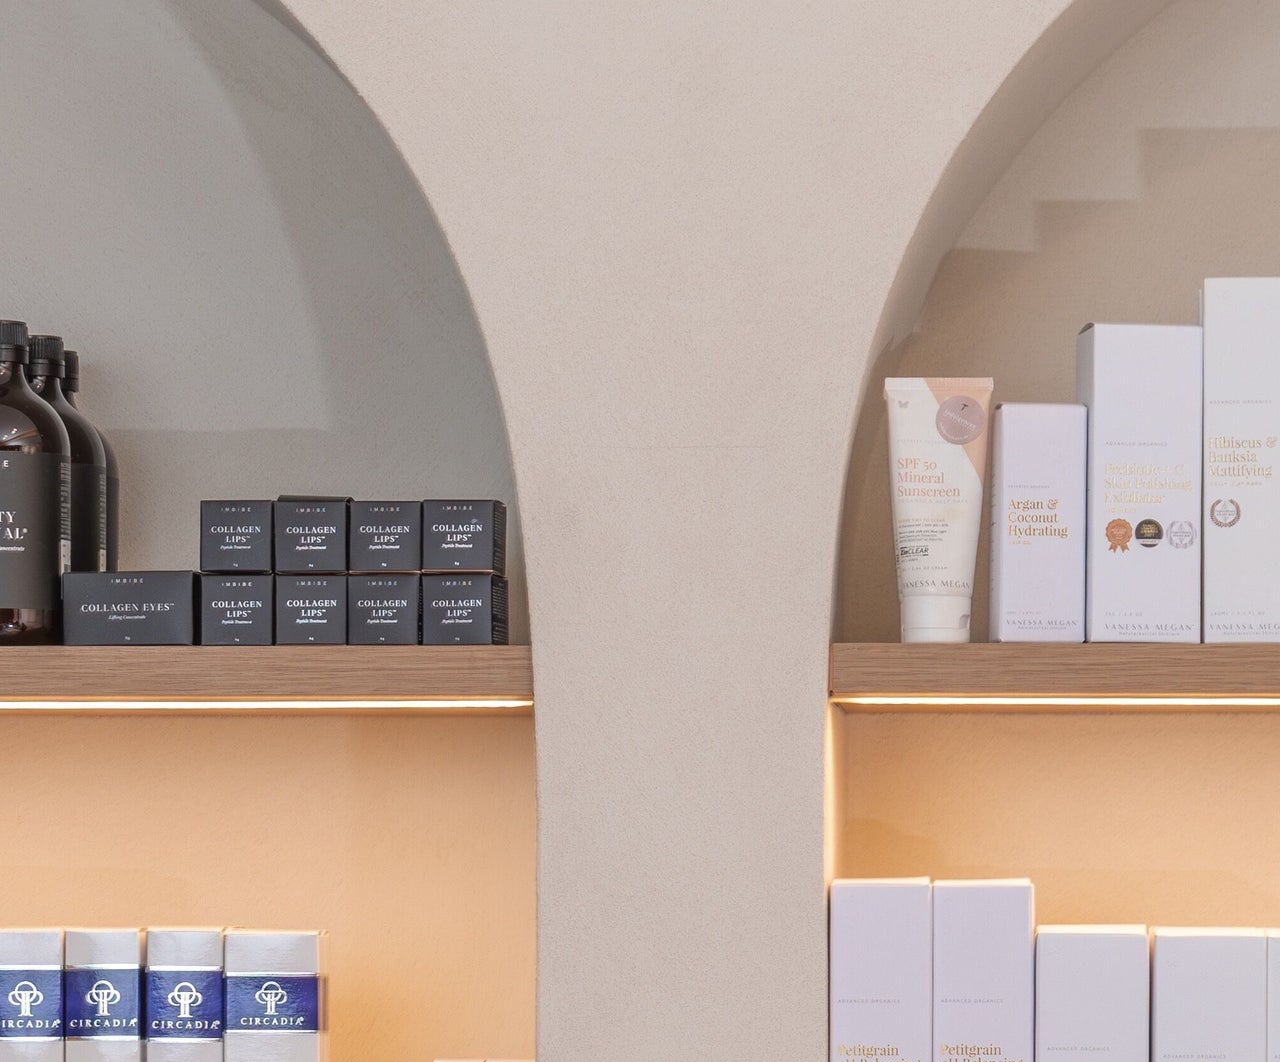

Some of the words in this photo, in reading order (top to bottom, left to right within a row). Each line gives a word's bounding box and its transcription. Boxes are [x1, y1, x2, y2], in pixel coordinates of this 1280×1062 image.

[1209, 436, 1262, 449] Hibiscus
[1266, 436, 1278, 449] &
[1209, 451, 1258, 463] Banksia
[897, 458, 921, 470] SPF
[922, 460, 938, 471] 50
[1209, 465, 1273, 478] Mattifying
[897, 472, 945, 484] Mineral
[896, 486, 961, 497] Sunscreen
[1008, 499, 1044, 511] Argan
[1047, 498, 1058, 510] &
[1008, 512, 1059, 524] Coconut
[210, 525, 262, 534] COLLAGEN
[359, 525, 410, 534] COLLAGEN
[1008, 525, 1068, 539] Hydrating
[81, 603, 140, 613] COLLAGEN
[211, 600, 262, 609] COLLAGEN
[837, 1044, 899, 1057] Petitgrain
